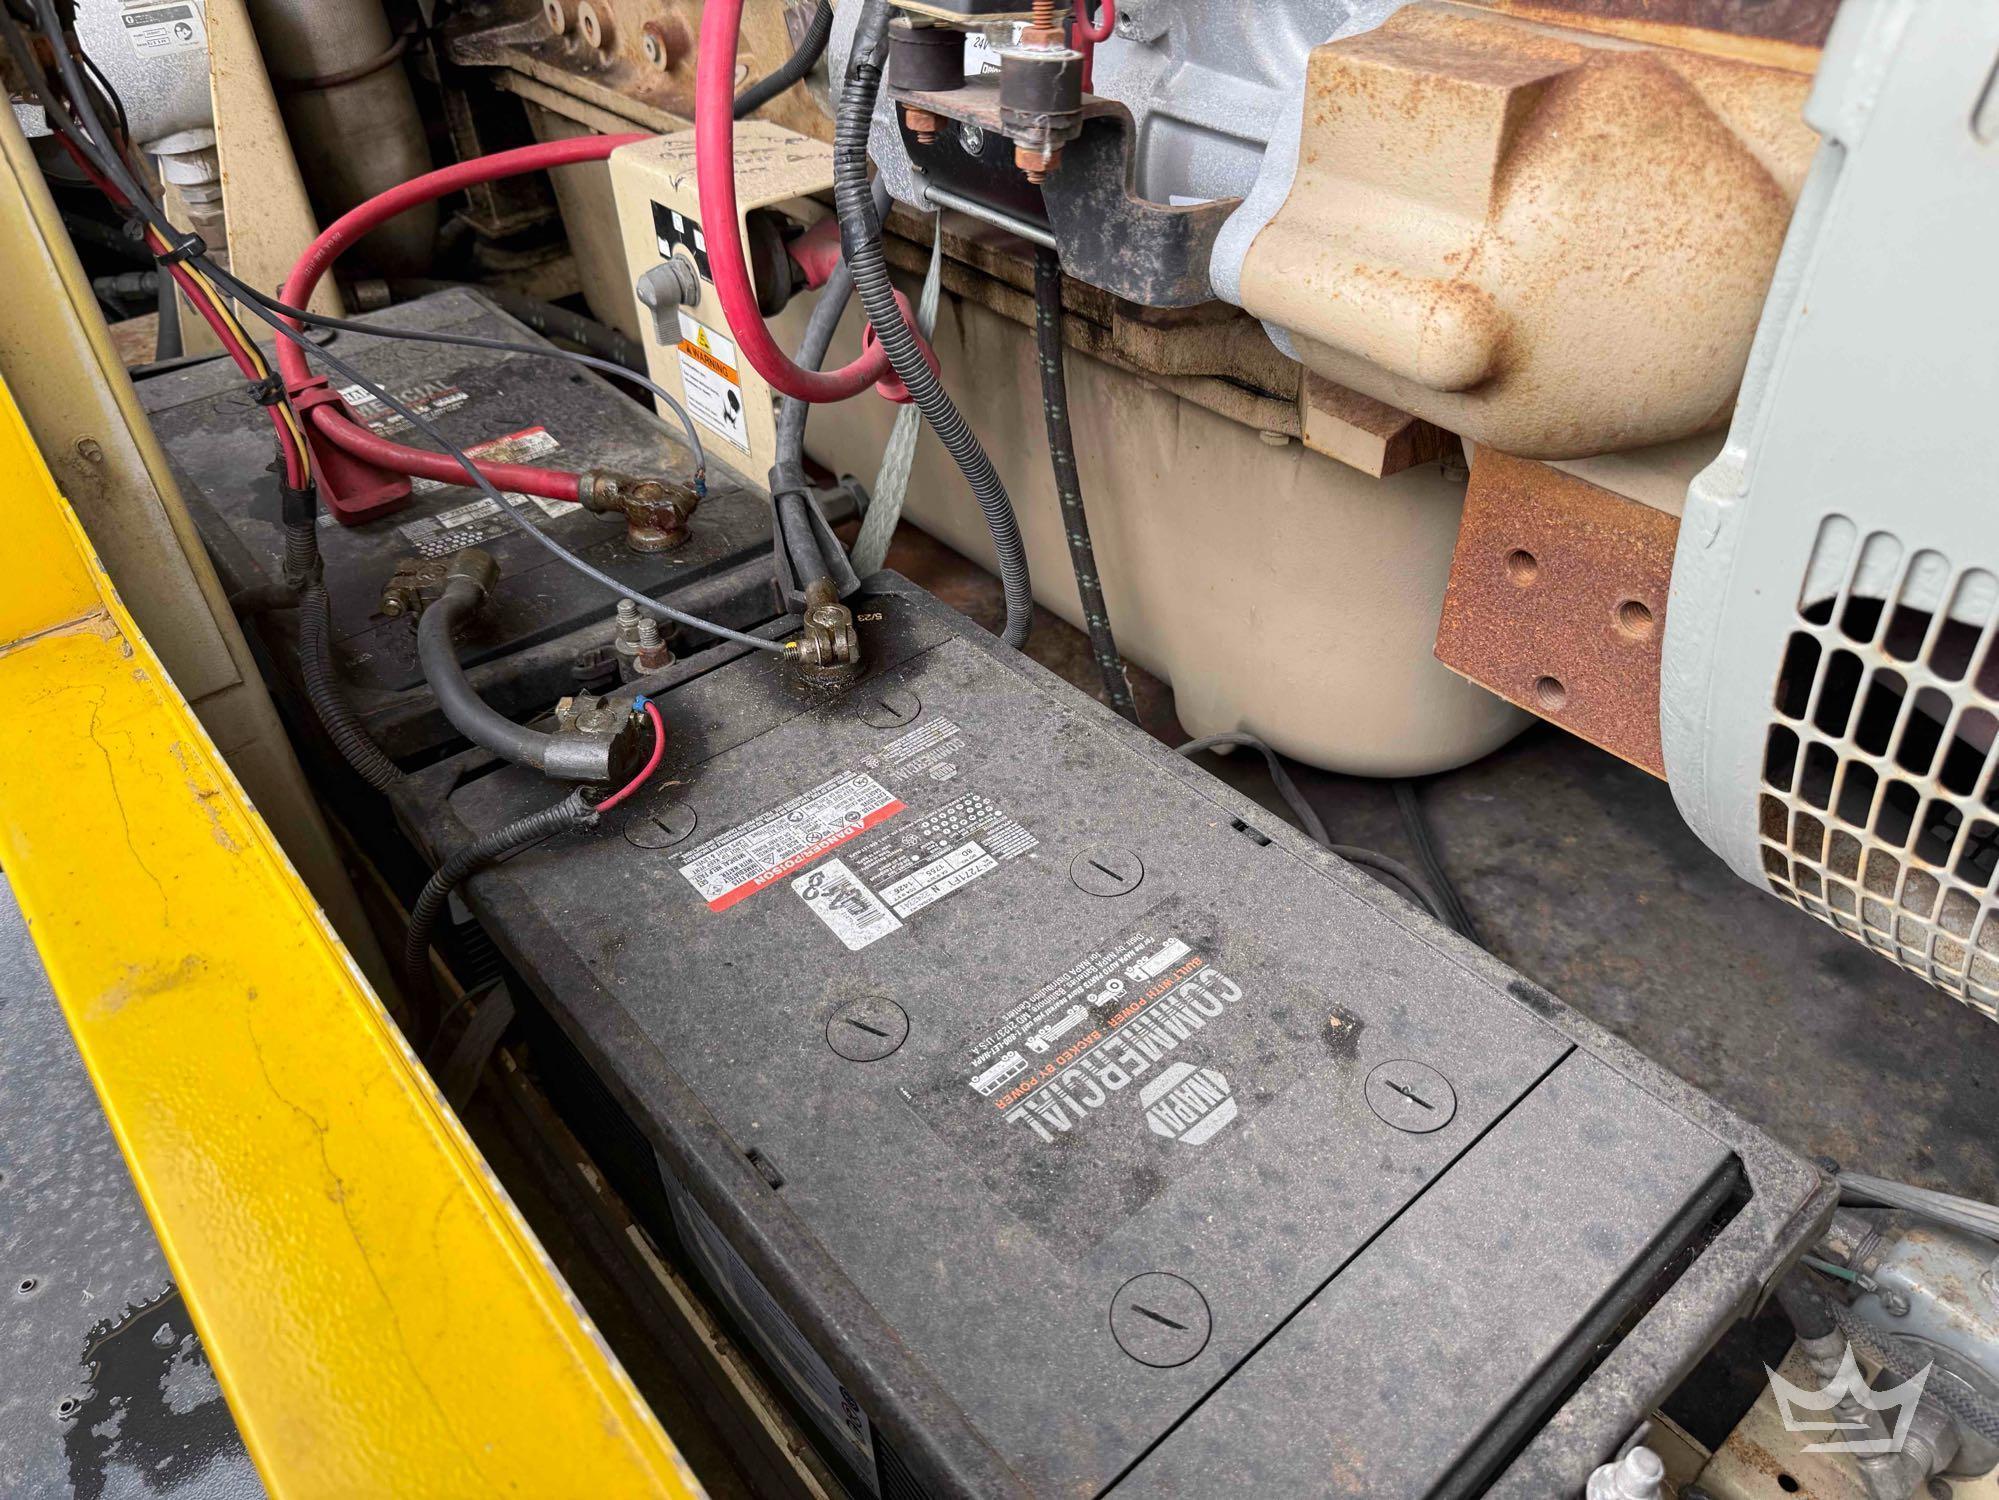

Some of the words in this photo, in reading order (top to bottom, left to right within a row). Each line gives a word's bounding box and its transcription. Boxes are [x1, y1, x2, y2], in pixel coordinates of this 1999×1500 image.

[692, 348, 729, 378] WARNING
[857, 612, 883, 621] 5/23
[888, 737, 968, 782] COMMERCIAL
[728, 846, 741, 855] NOT
[751, 826, 856, 886] DANGER/POISON
[959, 847, 973, 857] 8D
[704, 857, 720, 867] KEEP
[720, 852, 746, 867] MEDICAL
[737, 857, 754, 868] WITH
[691, 864, 706, 874] VENT
[707, 864, 723, 875] HELP
[722, 862, 758, 883] IMMEDIATELY
[744, 866, 763, 878] FLUSH
[924, 863, 945, 876] 1755
[696, 878, 709, 887] GET
[731, 875, 747, 886] EYES
[929, 884, 941, 893] N
[1123, 932, 1146, 947] Distr.
[1131, 942, 1147, 952] the
[1141, 936, 1157, 945] For
[1111, 943, 1128, 954] by
[1116, 949, 1137, 963] NAPA
[1086, 951, 1103, 962] for
[1093, 951, 1119, 968] NAPA
[1067, 958, 1092, 975] NAPA
[1100, 960, 1122, 975] AUTO
[1169, 956, 1205, 980] BUILT
[1062, 964, 1099, 990] Batteries,
[1080, 971, 1105, 989] PARTS
[1027, 972, 1072, 1003] Distribution
[1065, 985, 1086, 999] Store
[1143, 977, 1176, 999] WITH
[1027, 986, 1067, 1015] Baltimore,
[1042, 996, 1069, 1015] nearest
[1000, 999, 1032, 1022] Centers
[1013, 1011, 1032, 1024] MD
[1105, 996, 1149, 1027] POWER
[992, 1020, 1018, 1040] 21237
[1018, 1020, 1035, 1032] call
[1053, 1029, 1103, 1066] BACKED
[1003, 968, 1244, 1143] COMMERCIAL
[1035, 1062, 1057, 1080] BY
[993, 1075, 1040, 1111] POWER
[1151, 1073, 1226, 1133] NAPA
